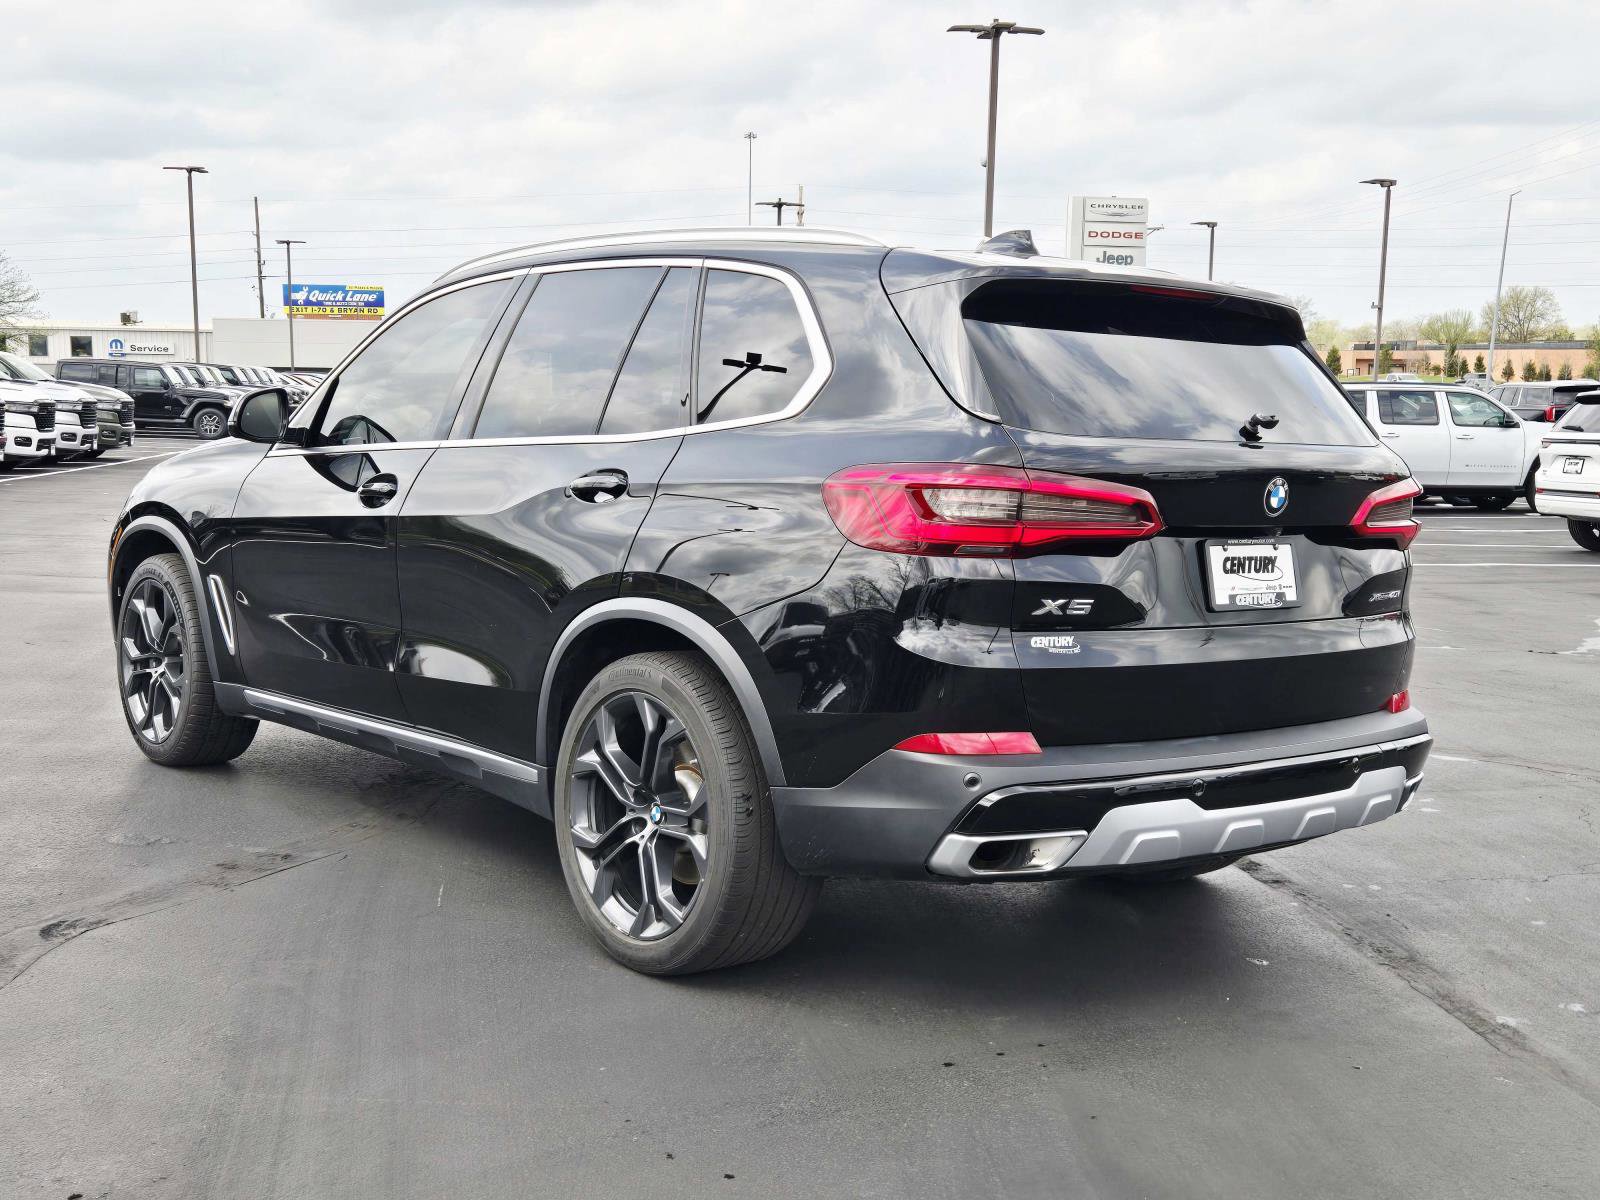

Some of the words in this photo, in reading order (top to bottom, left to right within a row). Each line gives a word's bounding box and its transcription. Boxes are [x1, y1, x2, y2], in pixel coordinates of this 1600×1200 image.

[1088, 230, 1144, 239] DODGE
[1096, 250, 1134, 266] Jeep
[309, 290, 345, 302] Quick
[345, 290, 377, 302] Lane
[130, 344, 169, 352] Service
[1222, 555, 1278, 574] CENTURY
[1235, 593, 1277, 605] CENTURY
[1031, 599, 1095, 615] X5
[1030, 636, 1075, 648] CENTURY
